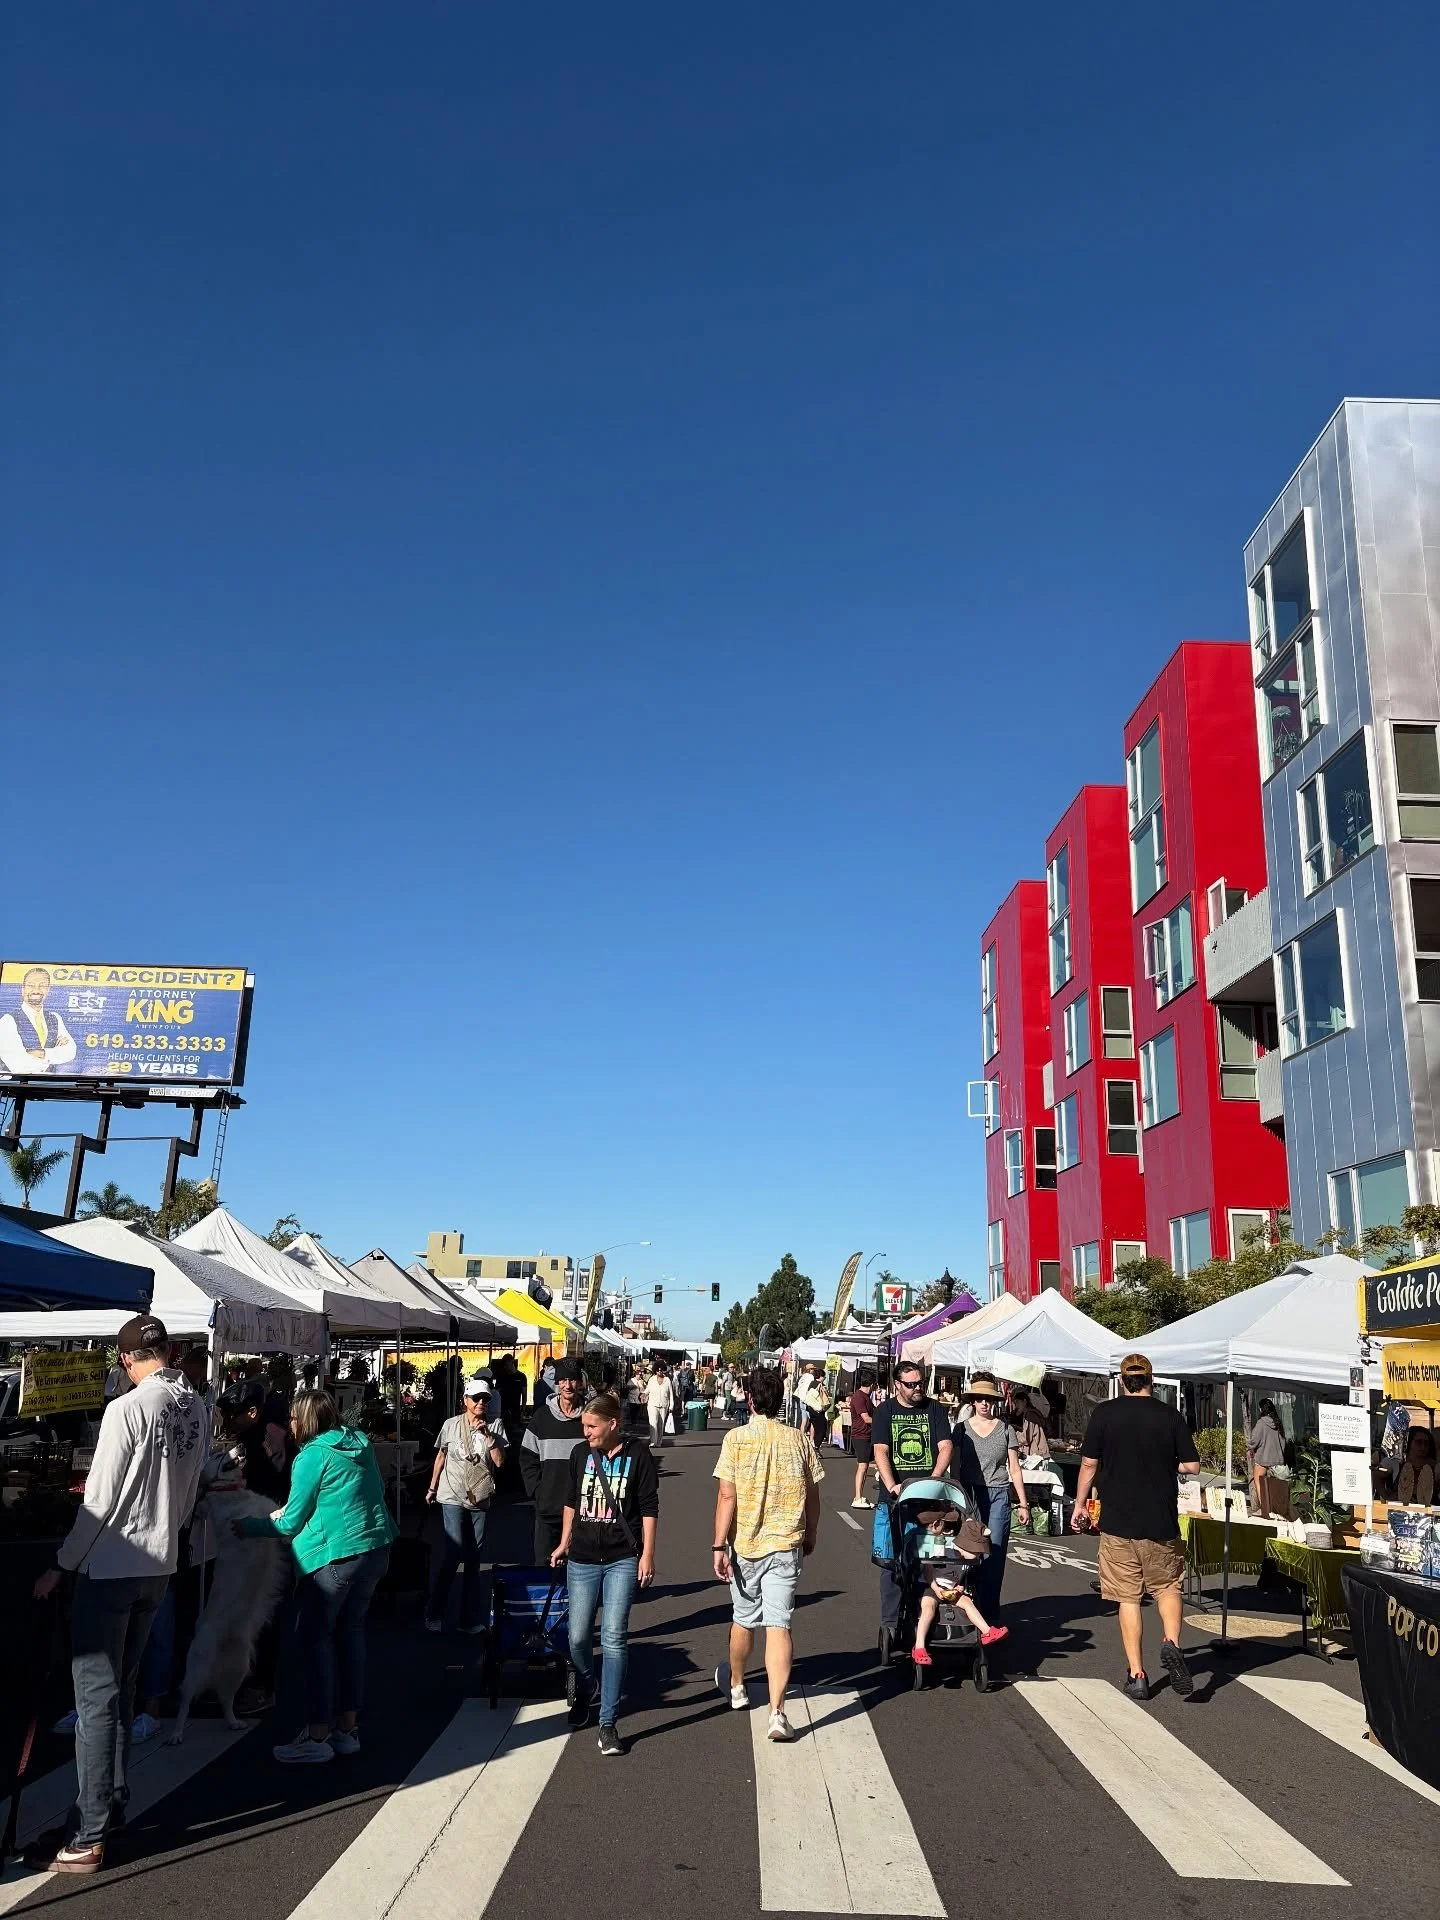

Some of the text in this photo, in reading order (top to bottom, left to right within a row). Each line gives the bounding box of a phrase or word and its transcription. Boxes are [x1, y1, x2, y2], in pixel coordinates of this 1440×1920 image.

[52, 968, 236, 985] CAR ACCIDENT?
[67, 996, 107, 1009] BEST
[129, 989, 196, 1000] ATTORNEY
[125, 998, 194, 1025] KING
[85, 1033, 226, 1052] 619.333.3333
[108, 1053, 200, 1063] HELPING CLIENTS FOR
[106, 1062, 199, 1075] 29 YEARS
[1376, 1273, 1424, 1314] Goldie
[90, 1369, 103, 1381] Sell
[1386, 1361, 1407, 1383] When
[1408, 1360, 1420, 1381] the
[1387, 1595, 1415, 1642] POP
